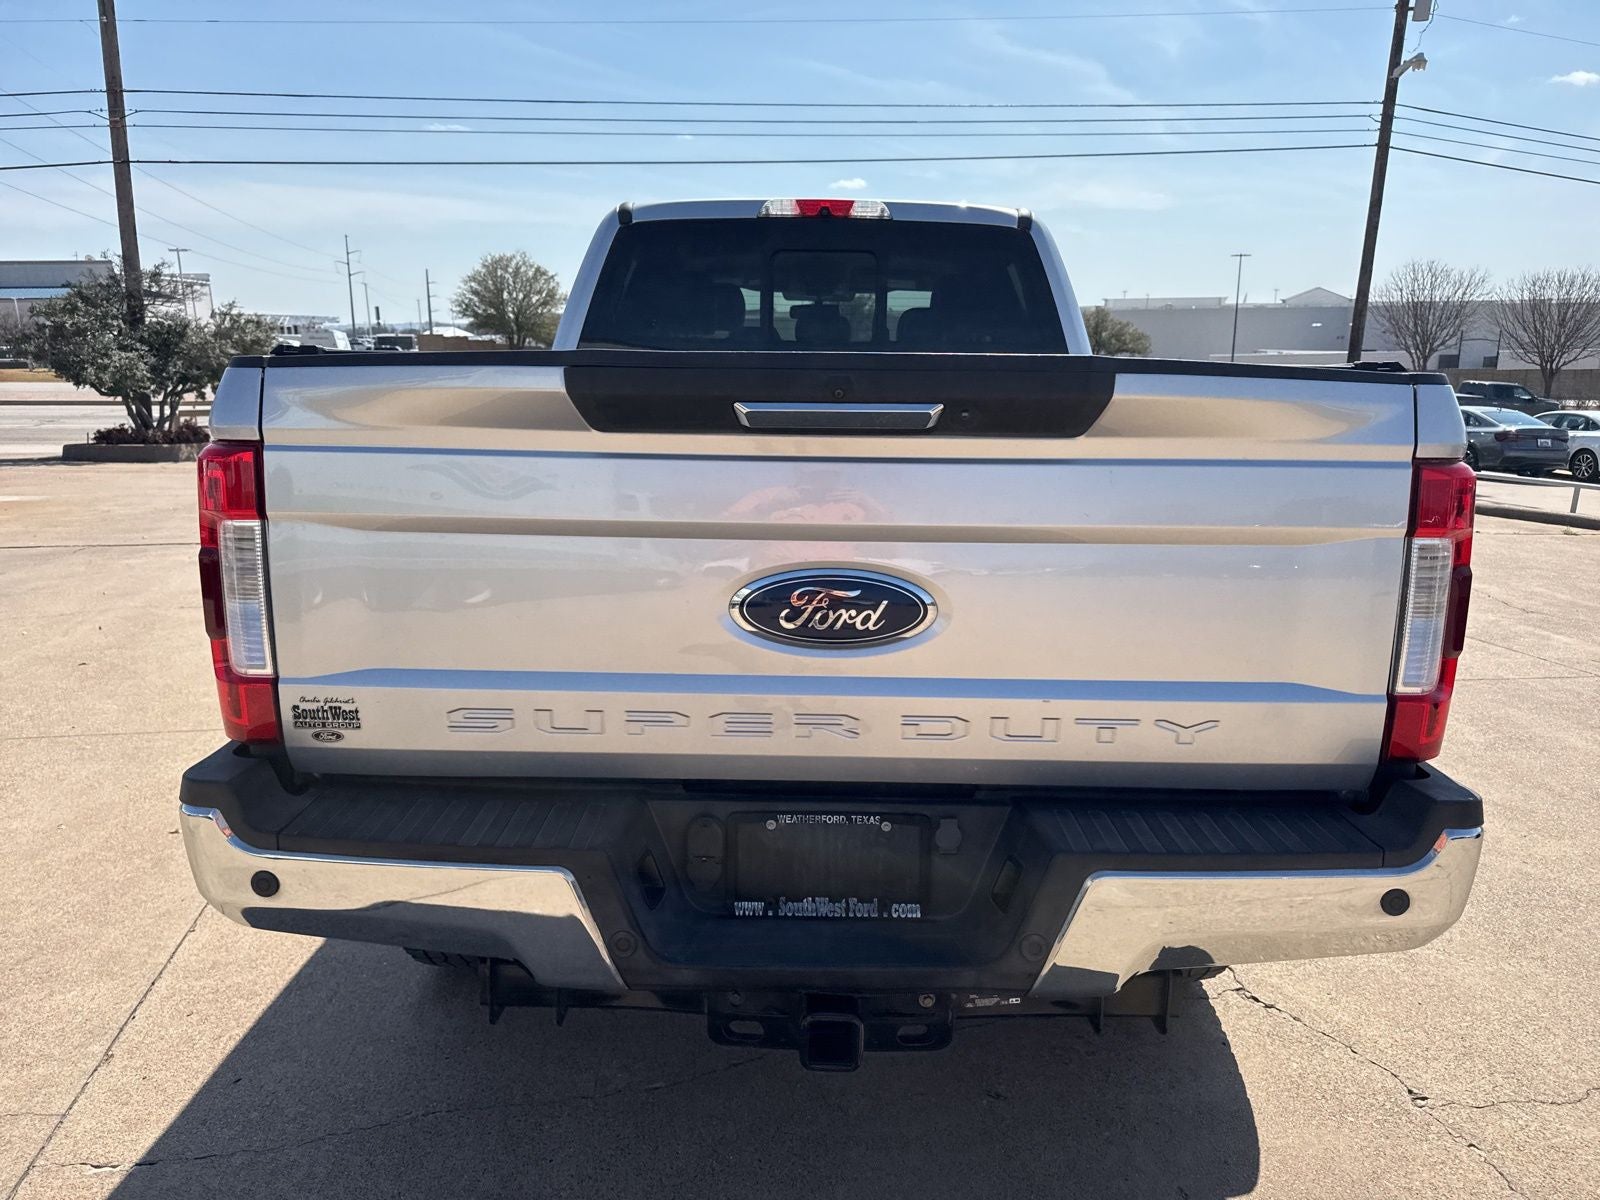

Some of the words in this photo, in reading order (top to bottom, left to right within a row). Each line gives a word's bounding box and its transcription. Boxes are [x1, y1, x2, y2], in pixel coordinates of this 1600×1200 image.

[778, 586, 889, 631] Ford
[291, 704, 361, 721] SouthWest
[446, 707, 861, 740] SUPER
[900, 714, 1220, 745] DUTY
[776, 814, 849, 825] WEATHERFORD,
[851, 815, 881, 825] TEXAS
